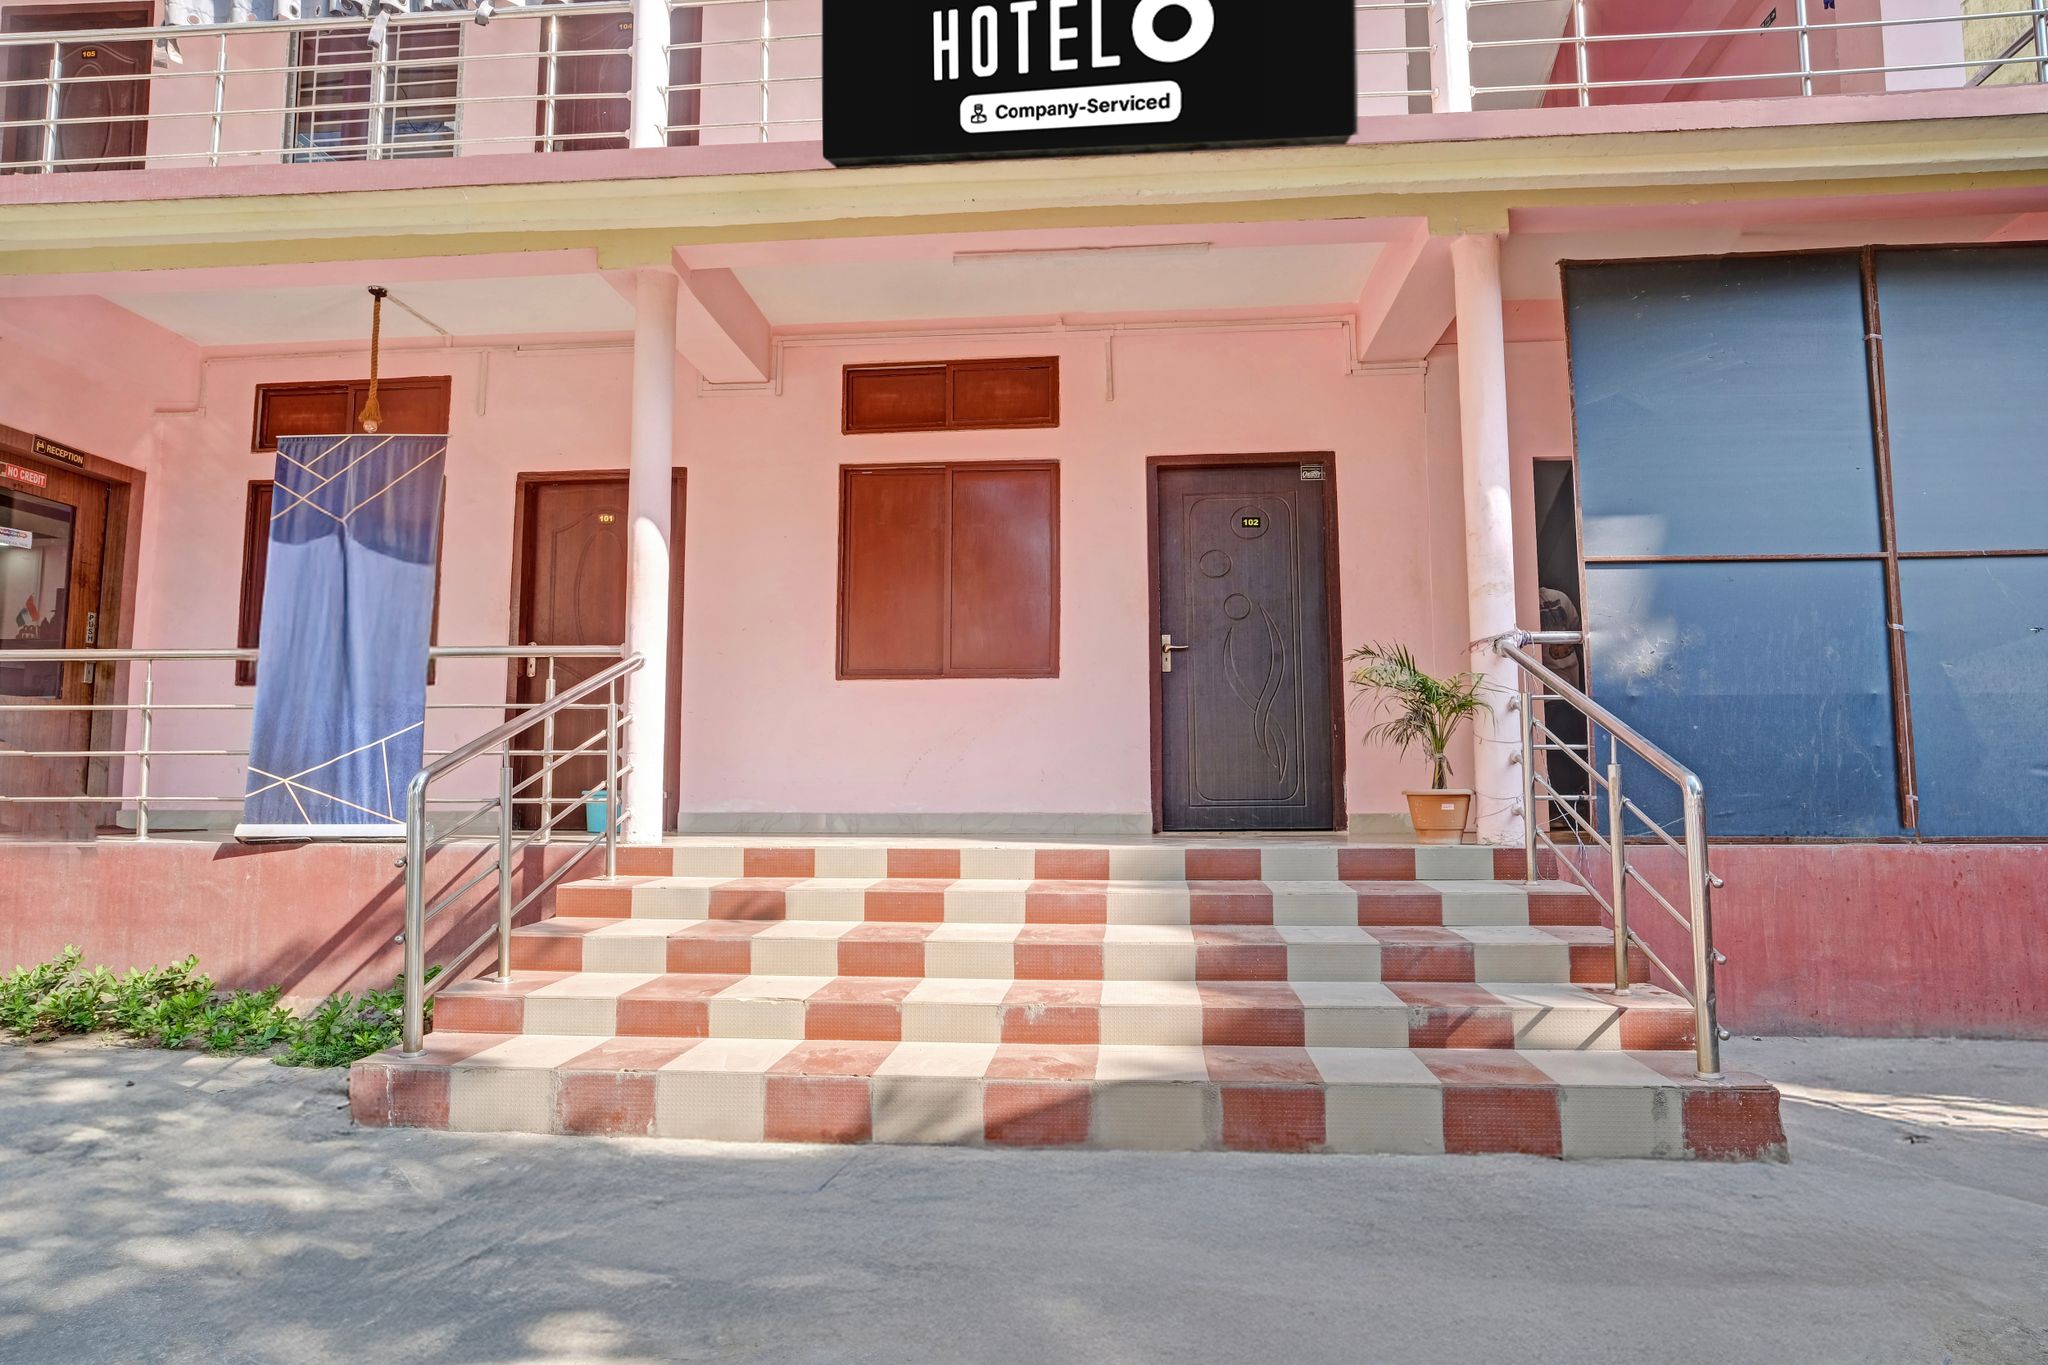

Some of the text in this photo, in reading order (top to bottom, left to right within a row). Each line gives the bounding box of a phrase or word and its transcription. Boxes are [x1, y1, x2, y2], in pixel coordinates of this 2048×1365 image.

[933, 0, 1121, 81] HOTEL
[82, 50, 96, 58] 105
[995, 92, 1171, 121] Company-Serviced
[46, 444, 84, 464] RECEPTION
[7, 465, 46, 486] NO CREDIT
[599, 514, 613, 522] 101
[1242, 518, 1259, 526] 102
